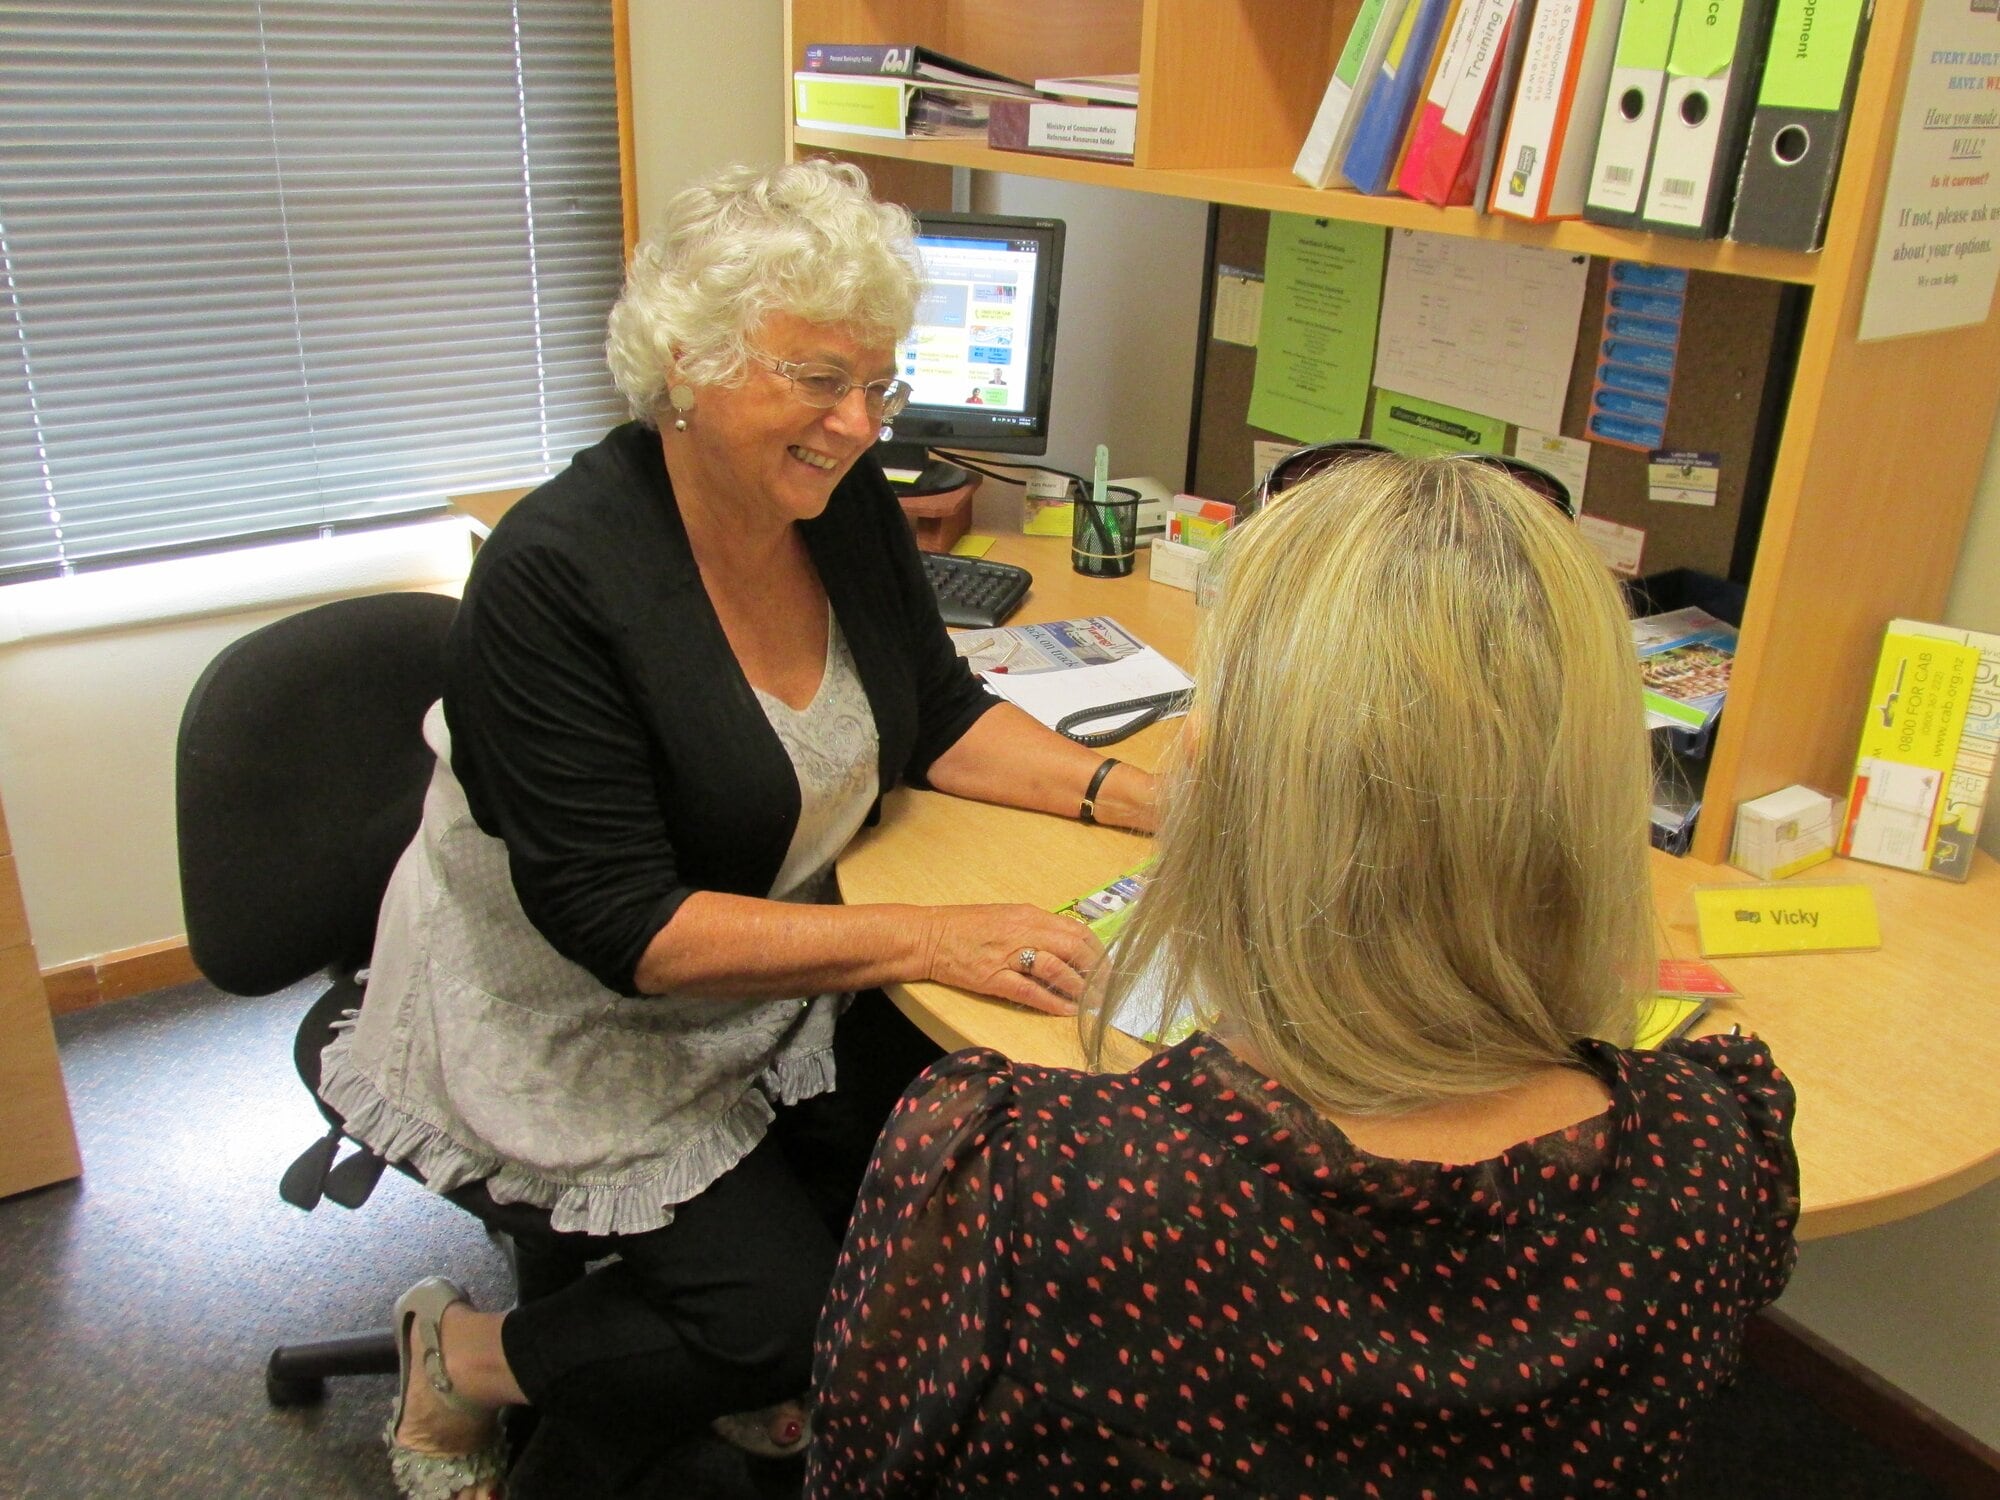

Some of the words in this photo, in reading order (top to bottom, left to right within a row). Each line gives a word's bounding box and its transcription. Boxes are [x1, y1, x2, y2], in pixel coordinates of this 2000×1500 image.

[1465, 11, 1503, 79] Training
[1544, 18, 1570, 100] Development
[1930, 51, 1966, 65] EVERY
[1046, 122, 1066, 132] Ministry
[1073, 124, 1098, 133] Consumer
[1099, 126, 1117, 134] Affairs
[1924, 108, 1953, 126] Have
[1953, 112, 1972, 127] you
[1972, 107, 1998, 126] made
[1046, 133, 1071, 142] Reference
[1072, 135, 1099, 144] Resources
[1930, 174, 1940, 188] Is
[1951, 171, 1990, 187] current?
[1899, 207, 1913, 227] If
[1935, 205, 1970, 230] please
[1971, 203, 1988, 222] ask
[1893, 242, 1926, 262] about
[1926, 243, 1955, 263] your
[1914, 652, 1933, 682] CAB
[1906, 686, 1924, 716] FOR
[1934, 656, 1965, 758] www.cab.org.nz
[1898, 720, 1917, 753] 0800
[1769, 908, 1820, 928] Vicky
